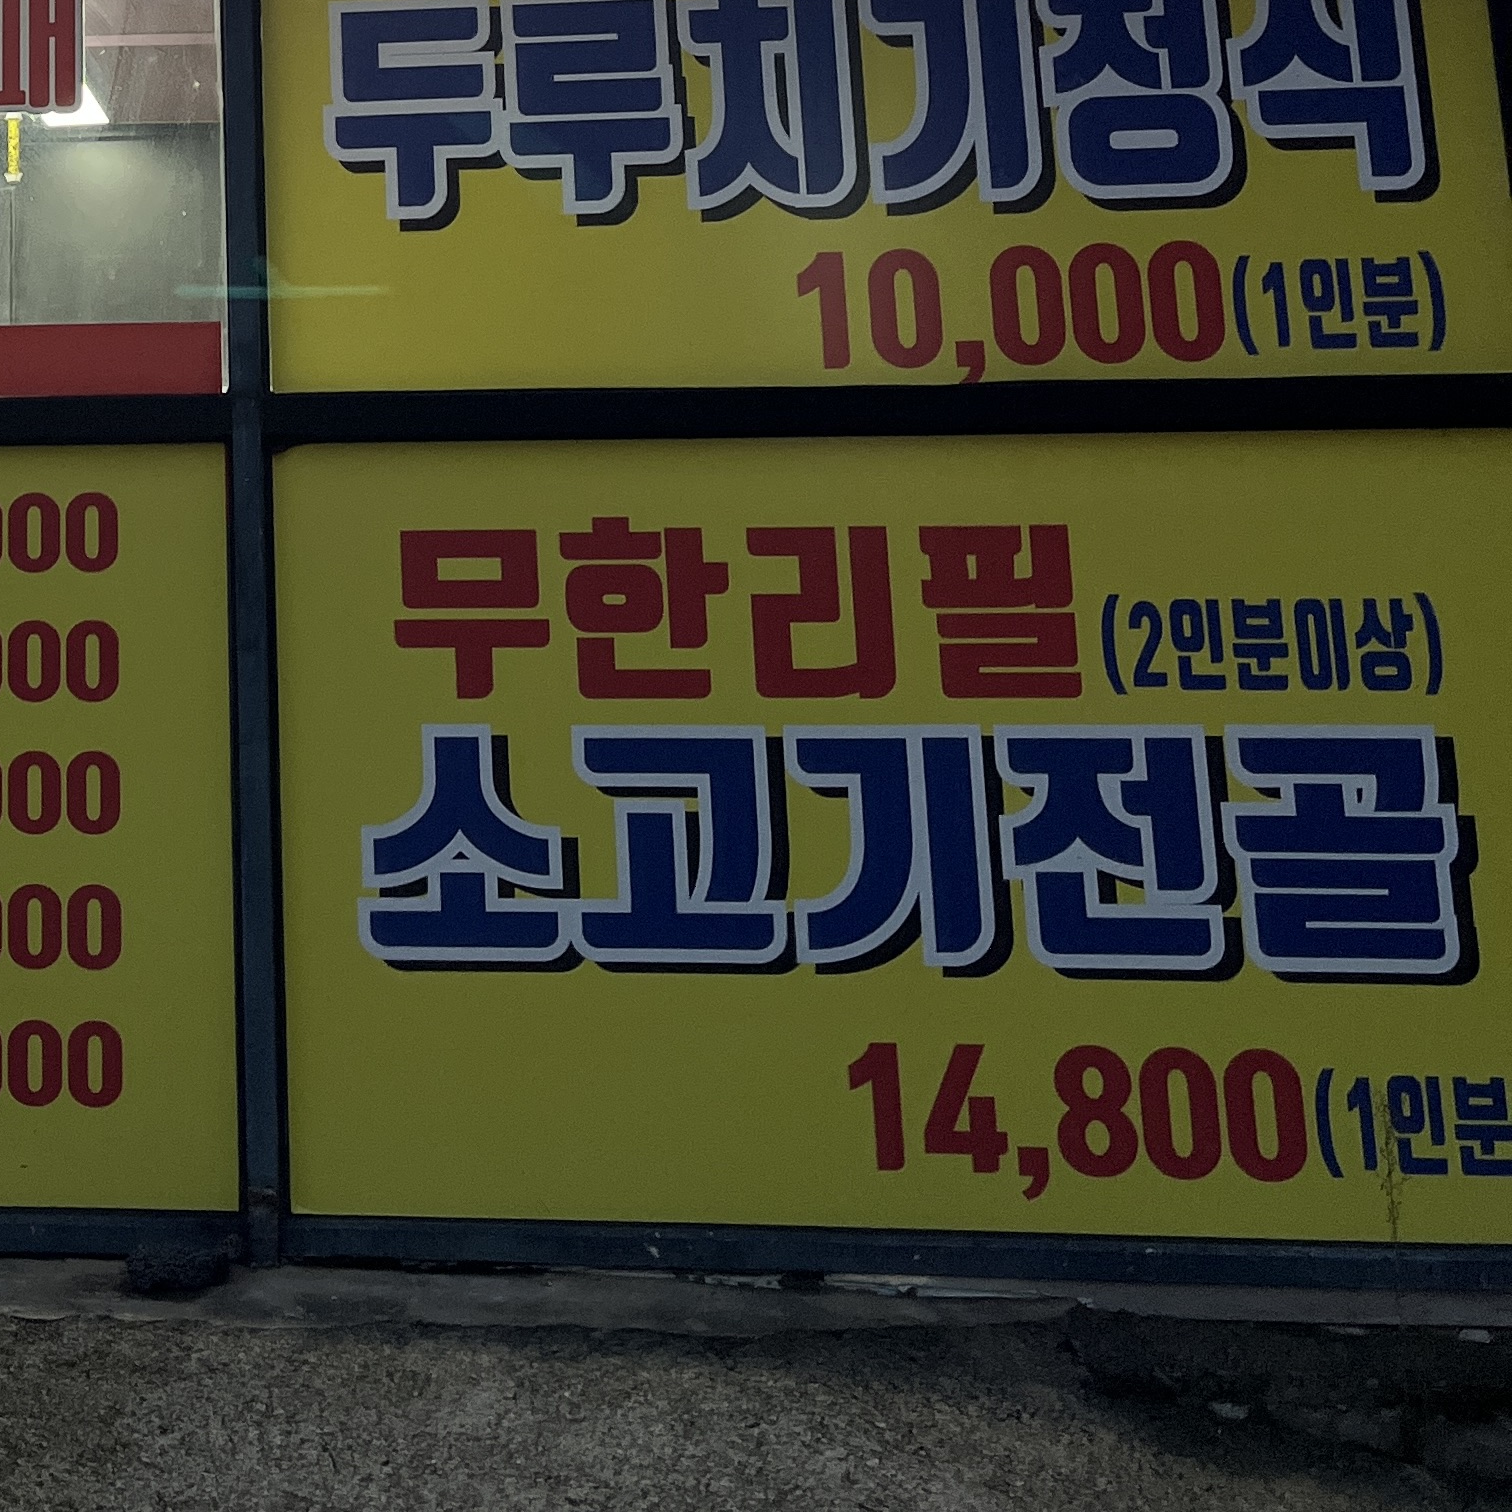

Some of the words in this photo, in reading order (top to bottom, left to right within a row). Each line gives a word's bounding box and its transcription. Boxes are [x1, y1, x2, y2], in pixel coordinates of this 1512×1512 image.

[797, 240, 1226, 385] 10,000
[1231, 252, 1448, 356] (1인분)
[394, 516, 1083, 700] 무한리필
[1100, 592, 1444, 695] (2인분이상)
[357, 724, 1468, 978] 소고기전골
[847, 1042, 1308, 1201] 14,800
[1315, 1068, 1512, 1178] (1인분
